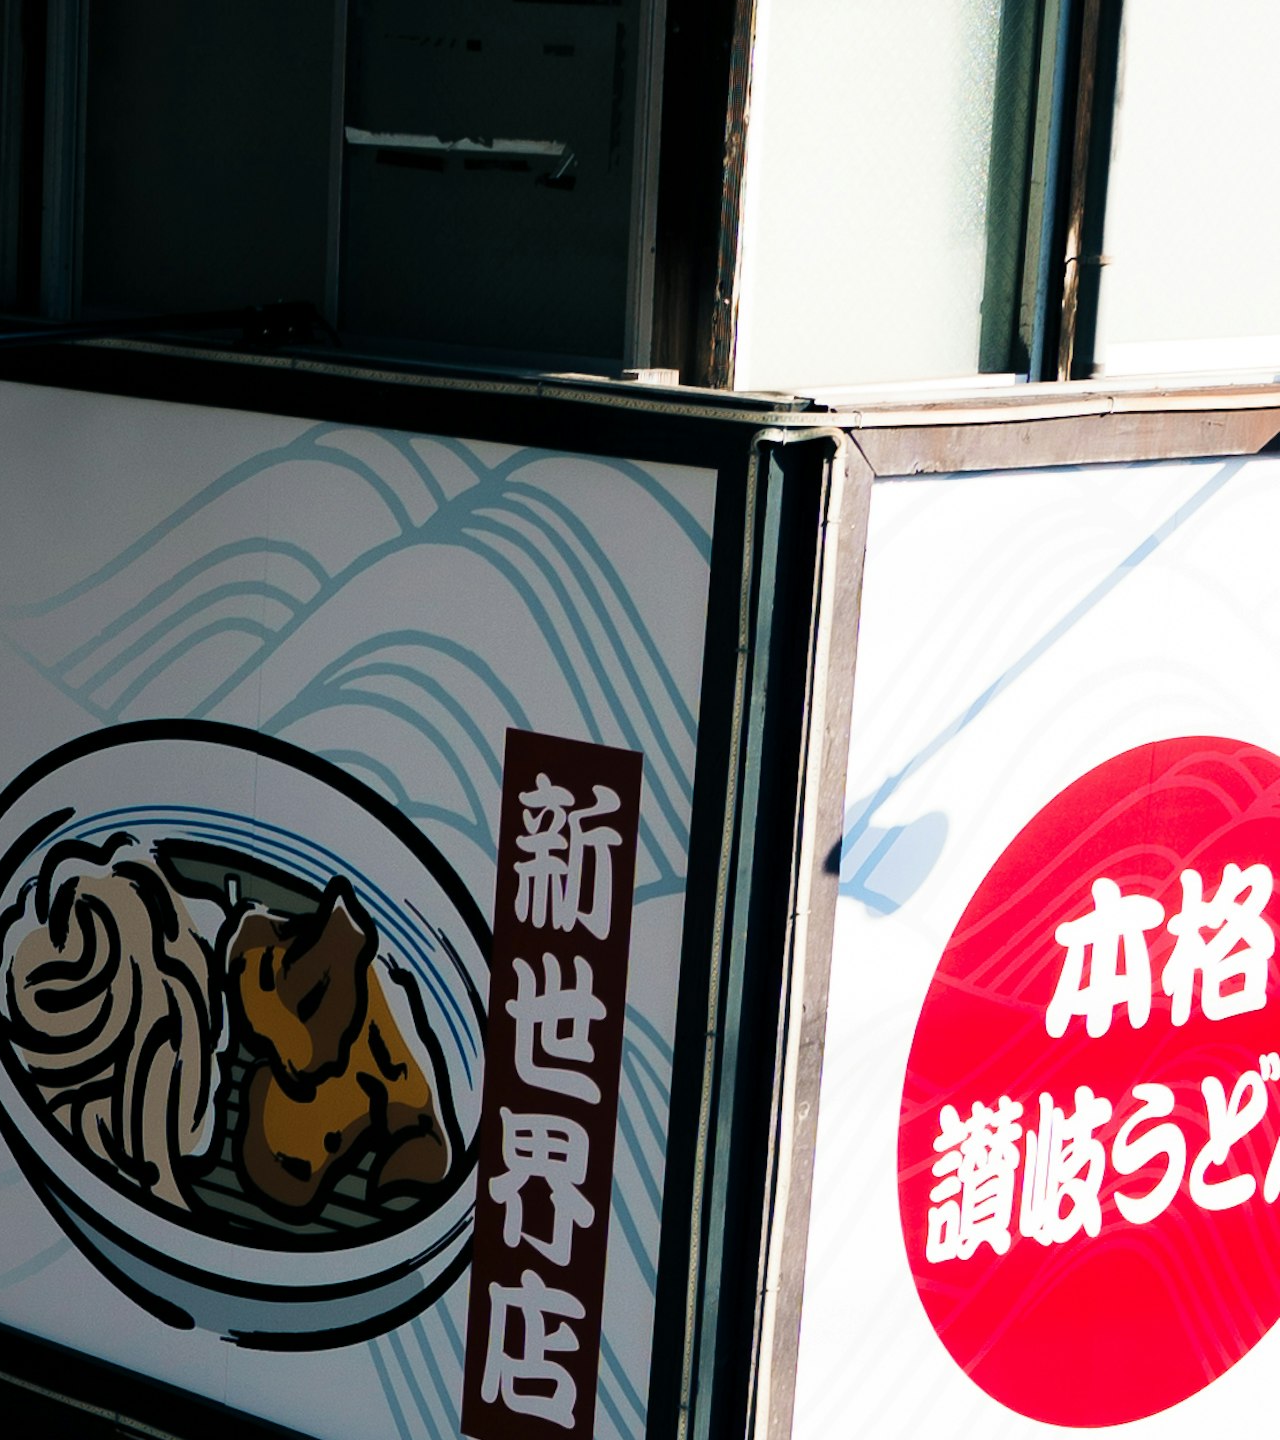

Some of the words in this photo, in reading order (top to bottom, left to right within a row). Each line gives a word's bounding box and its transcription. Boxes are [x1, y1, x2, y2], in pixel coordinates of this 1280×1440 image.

[1045, 861, 1276, 1040] 本格
[479, 771, 623, 1433] 新世界店
[927, 1051, 1280, 1262] 讃岐うど
